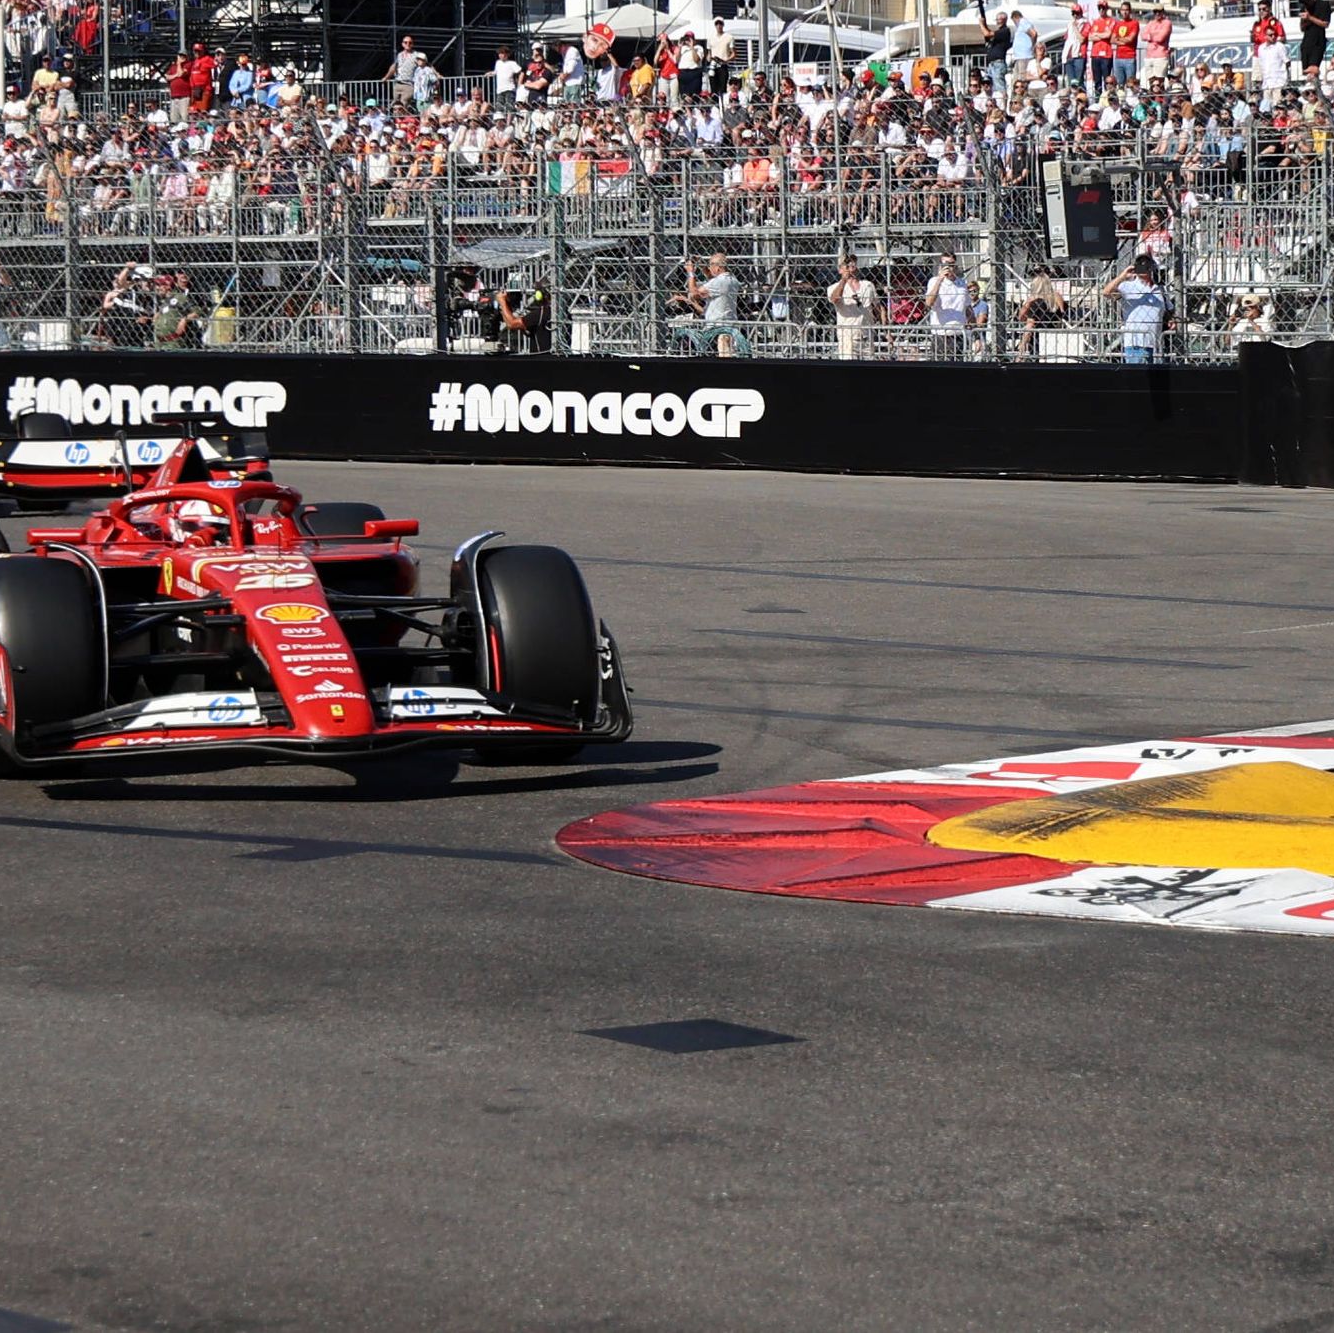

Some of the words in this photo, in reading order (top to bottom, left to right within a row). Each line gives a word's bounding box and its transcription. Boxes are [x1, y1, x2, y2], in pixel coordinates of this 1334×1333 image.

[7, 377, 287, 427] #MonacoGP
[430, 382, 765, 438] #MonacoGP
[66, 443, 90, 465] hp
[138, 441, 162, 462] hp
[281, 627, 324, 636] aws
[296, 691, 366, 704] Santander
